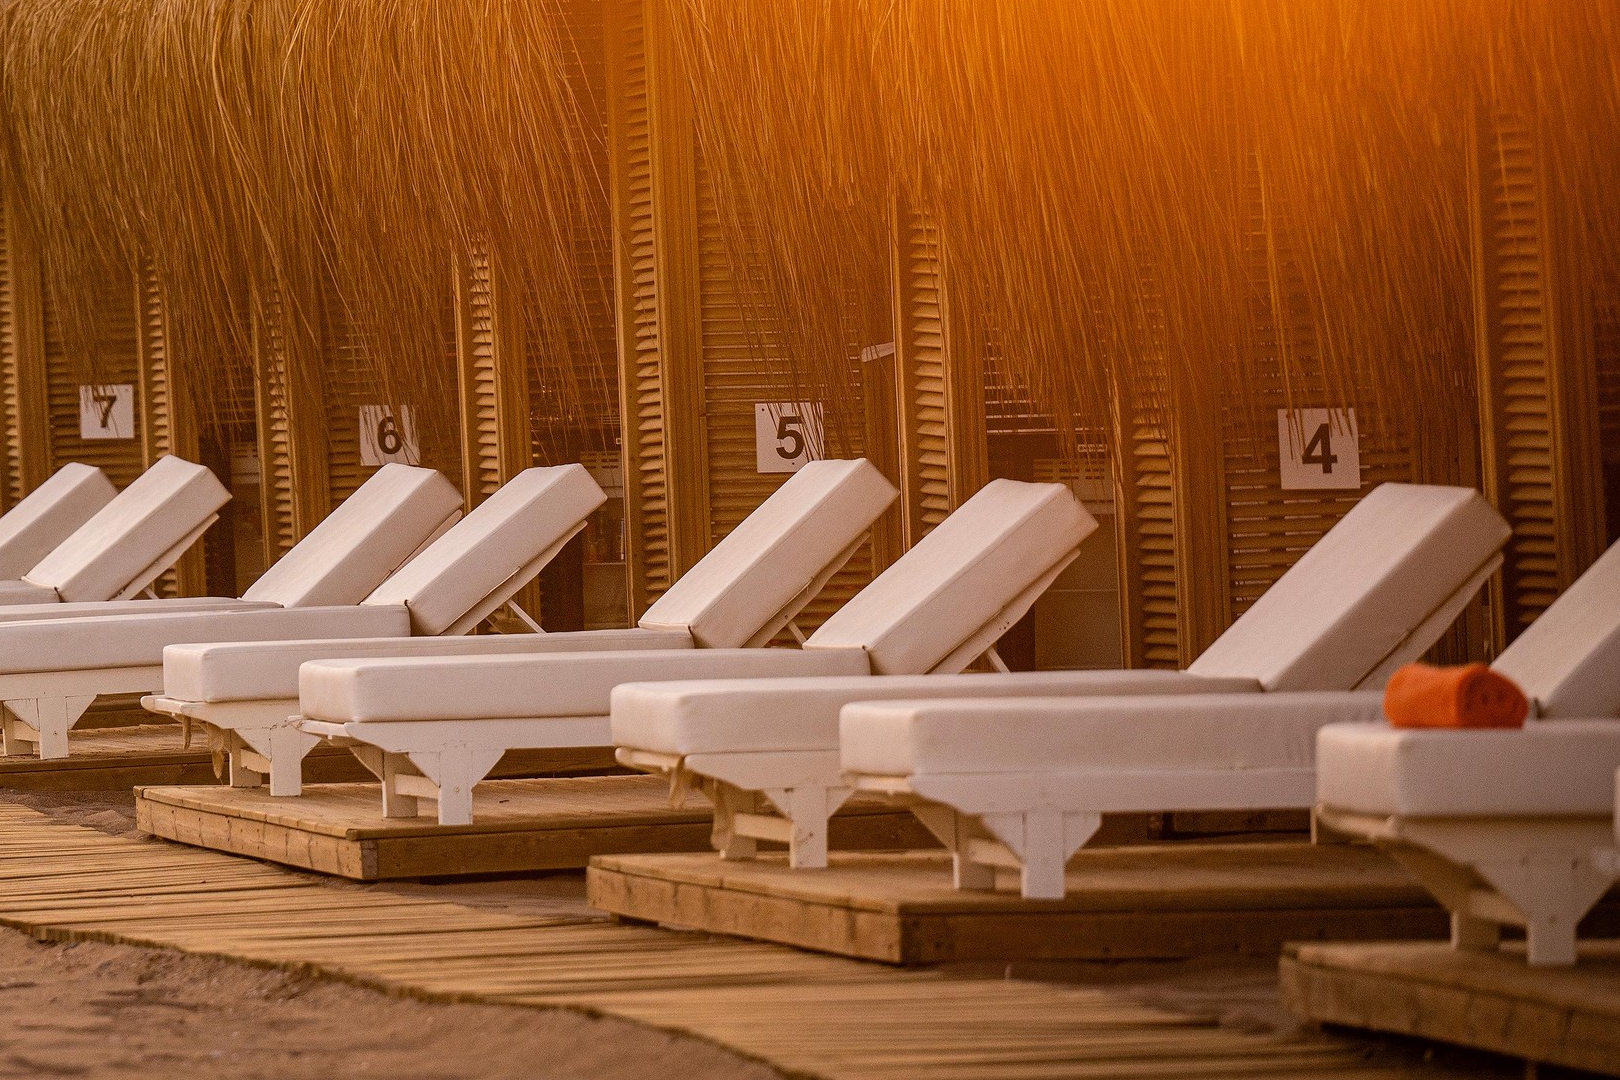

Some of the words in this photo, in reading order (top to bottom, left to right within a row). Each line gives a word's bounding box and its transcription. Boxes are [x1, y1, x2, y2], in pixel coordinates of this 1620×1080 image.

[93, 394, 117, 428] 7
[378, 416, 402, 455] 6
[776, 415, 805, 460] 5
[1302, 423, 1337, 474] 4
